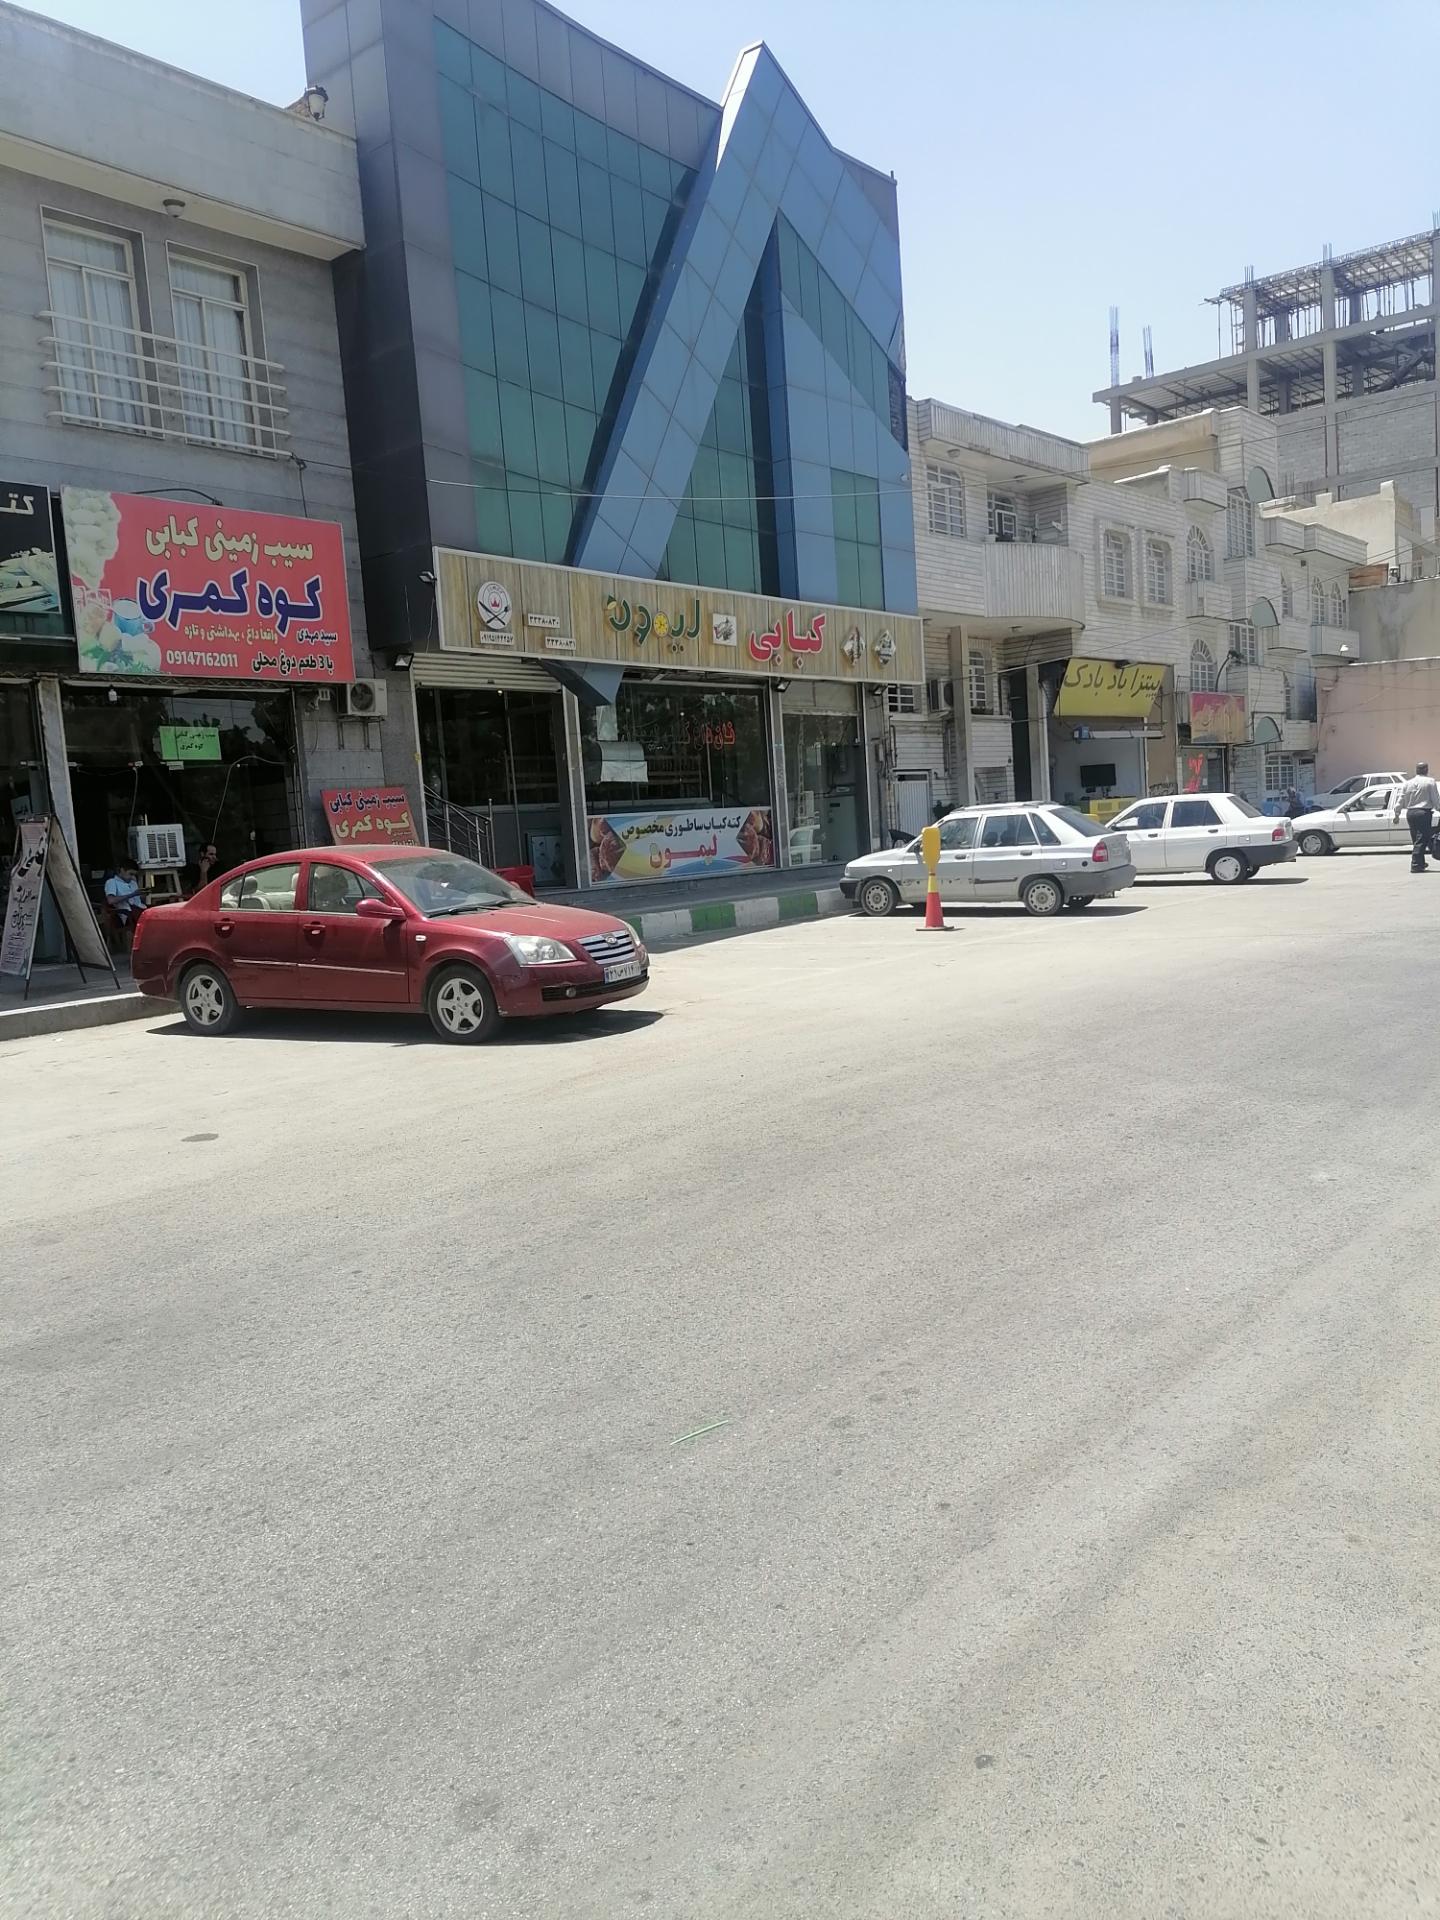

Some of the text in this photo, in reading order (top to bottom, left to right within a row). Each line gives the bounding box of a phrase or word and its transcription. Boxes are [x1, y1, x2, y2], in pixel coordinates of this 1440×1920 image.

[0, 492, 34, 515] کت
[146, 515, 314, 568] سیب زمینی کبابی
[137, 567, 323, 636] کوه کمری
[296, 628, 338, 646] سید مهدی
[749, 607, 826, 669] کبابی
[166, 649, 239, 668] 09147162011
[252, 650, 278, 673] محلی
[280, 648, 297, 675] دوغ
[1107, 666, 1127, 696] باد
[329, 790, 406, 815] سیب زمینی کبابی
[335, 811, 411, 839] کوه کمری
[621, 820, 665, 840] مخصوص
[727, 816, 742, 829] کته
[649, 833, 718, 869] لیمون
